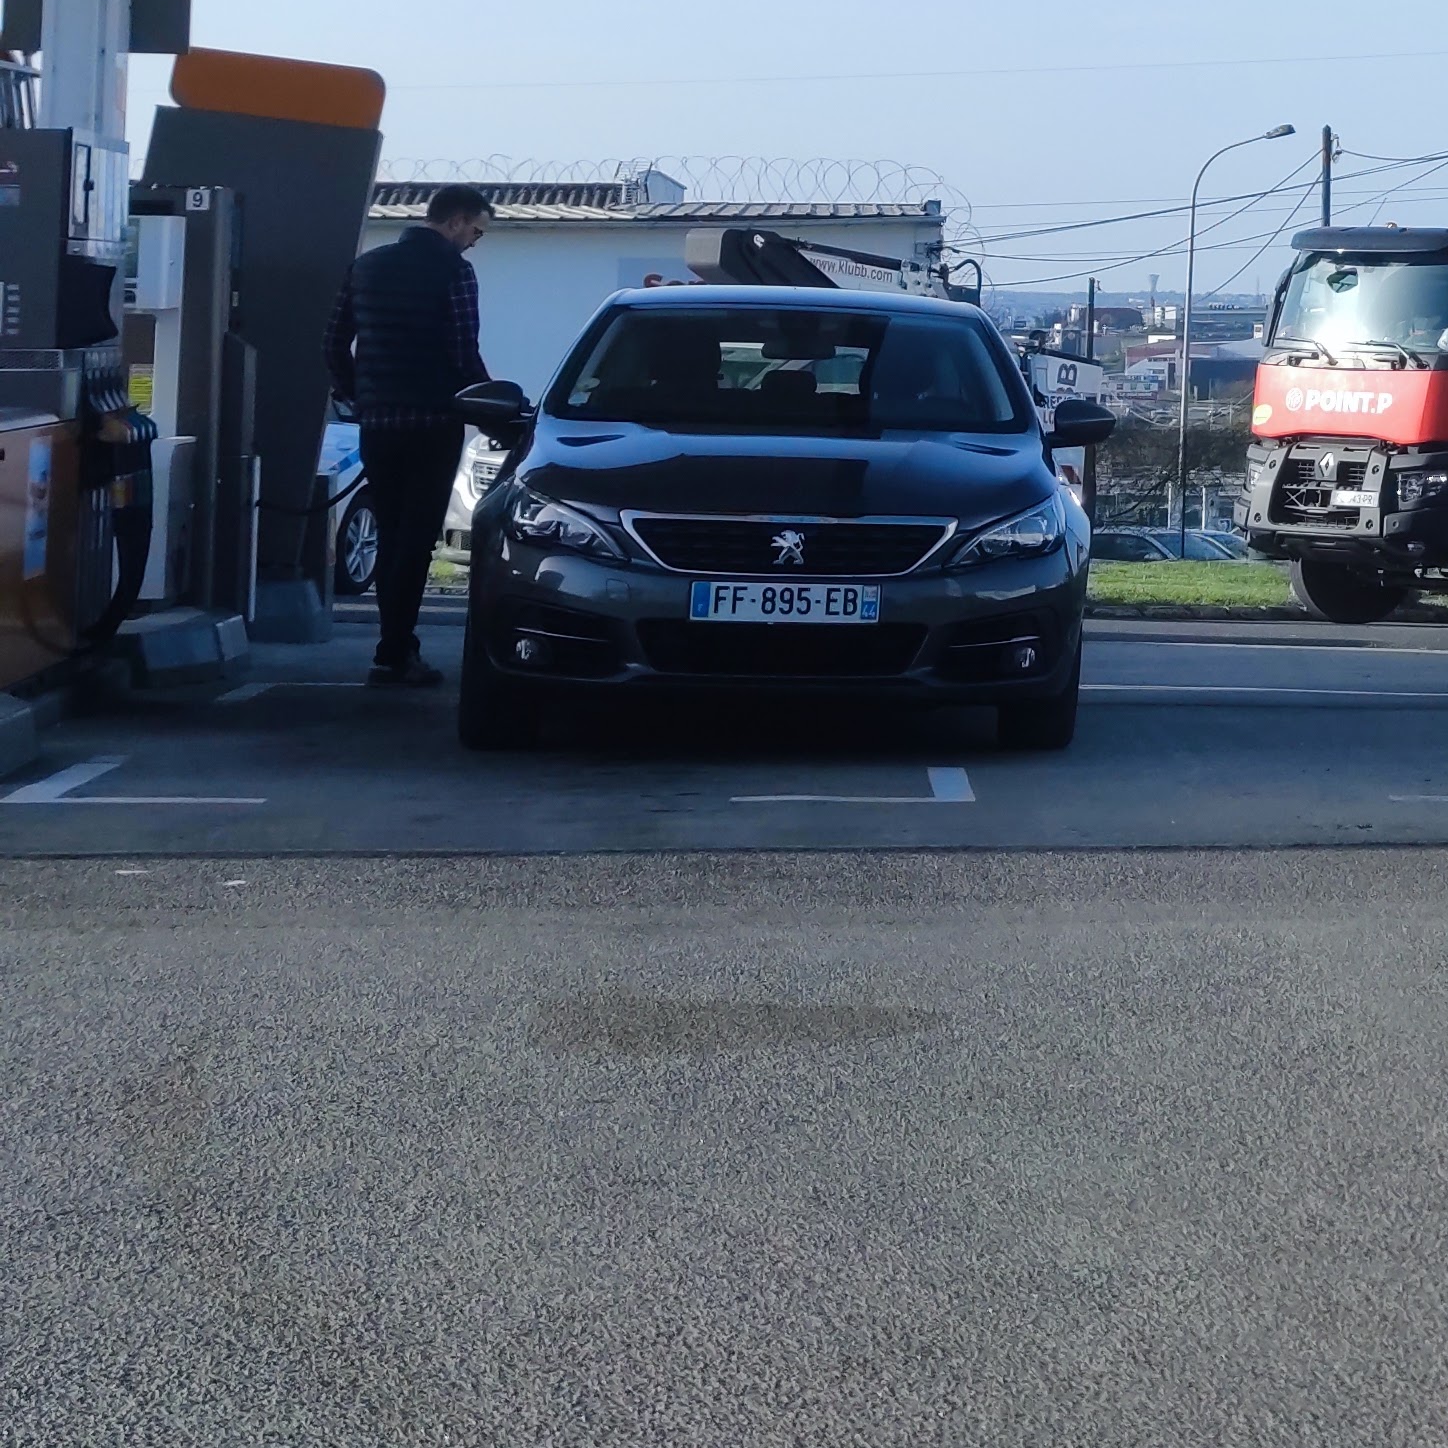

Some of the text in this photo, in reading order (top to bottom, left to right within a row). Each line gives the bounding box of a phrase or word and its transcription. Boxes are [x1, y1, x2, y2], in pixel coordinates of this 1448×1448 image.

[192, 191, 203, 208] 9
[1305, 389, 1393, 414] POINT.P
[713, 585, 859, 616] FF-895-EB
